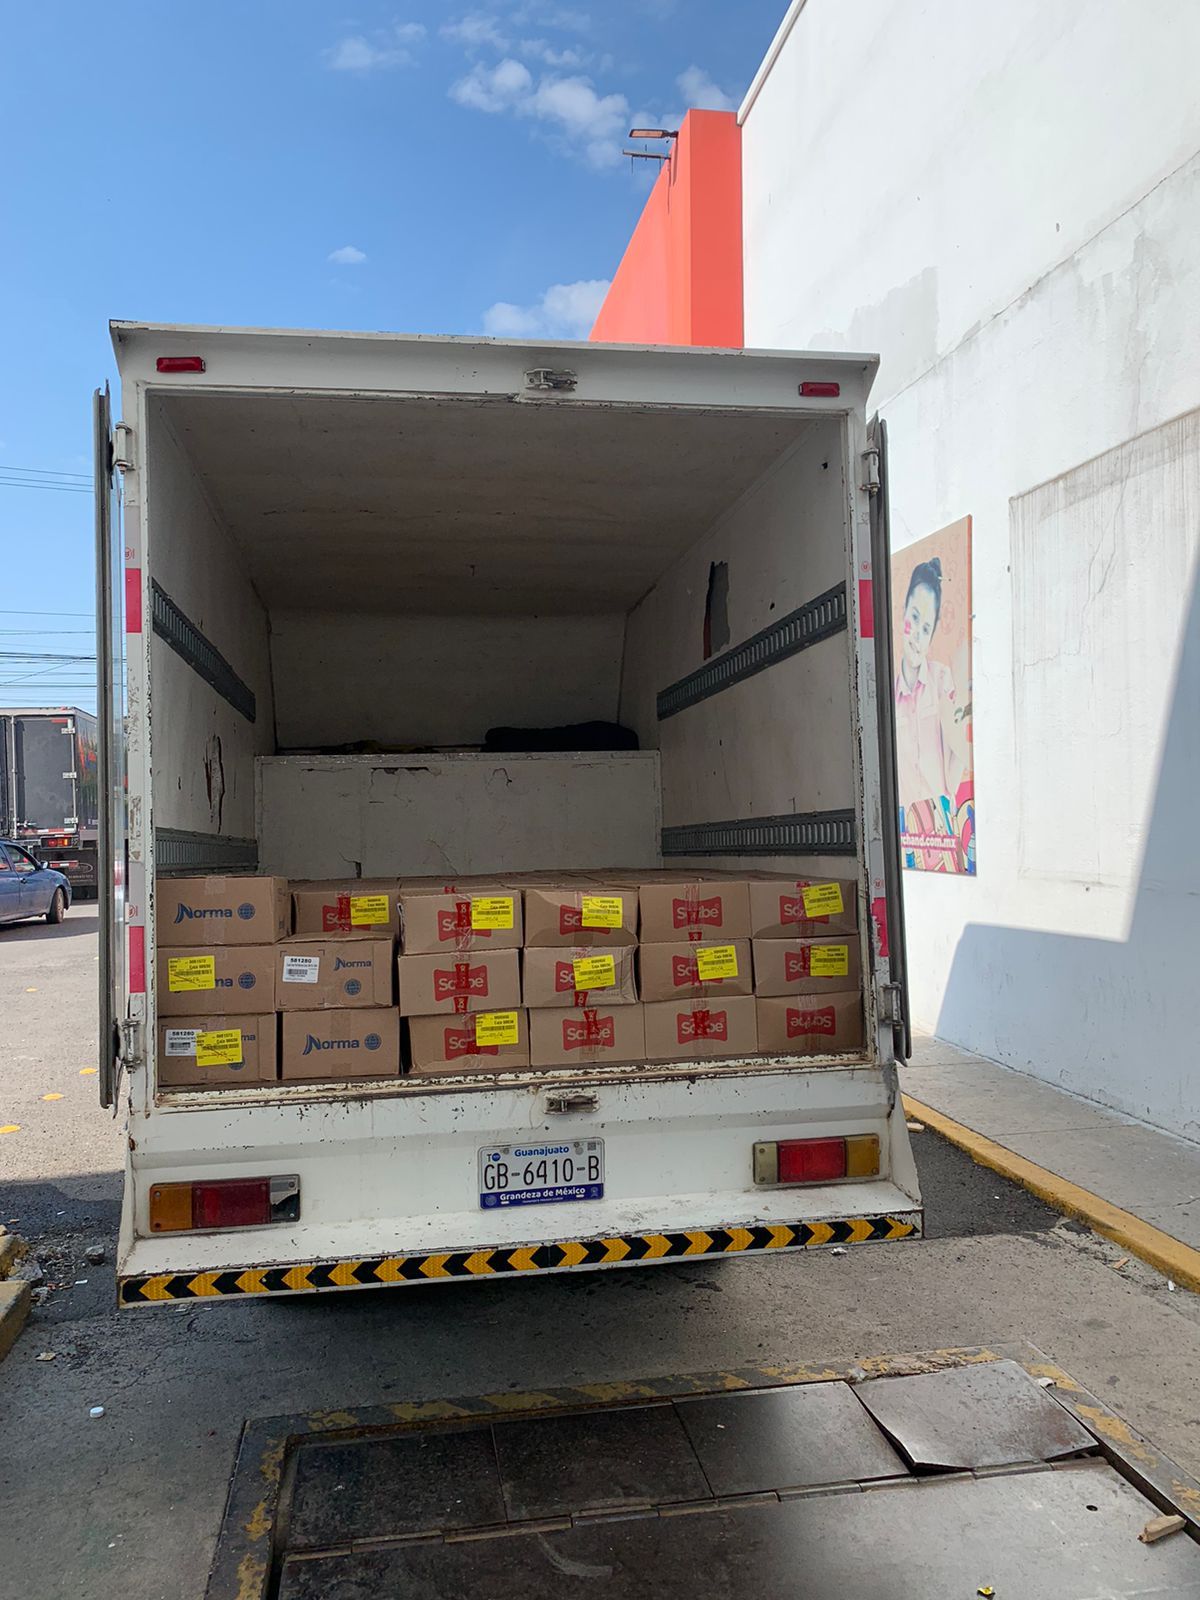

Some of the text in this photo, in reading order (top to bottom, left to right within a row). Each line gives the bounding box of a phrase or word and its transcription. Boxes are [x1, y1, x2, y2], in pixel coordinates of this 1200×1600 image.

[174, 903, 233, 924] Norma
[333, 957, 372, 971] Norma
[302, 1034, 360, 1055] Norma
[514, 1145, 570, 1158] Guanajuato
[484, 1155, 600, 1190] GB-6410-B
[499, 1191, 542, 1202] Grandeza
[543, 1189, 554, 1197] de
[555, 1186, 586, 1197] México
